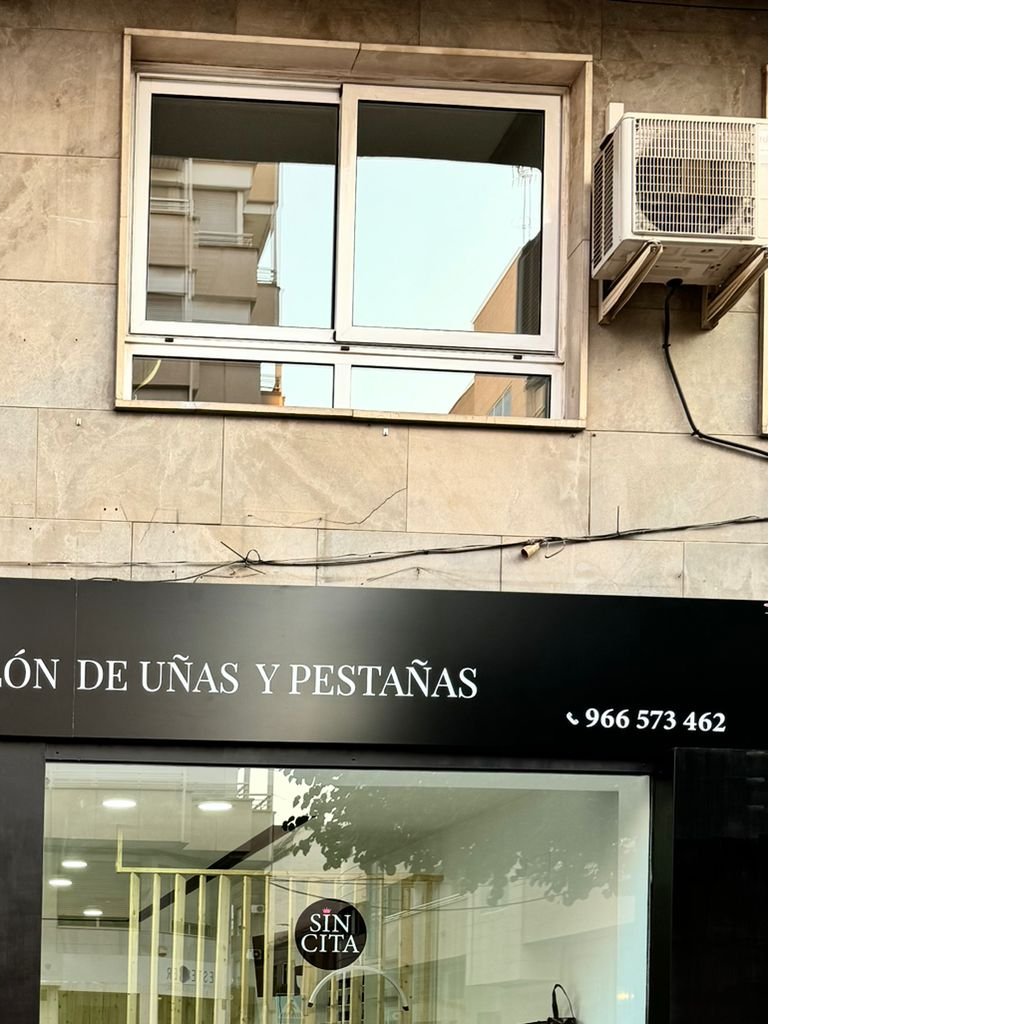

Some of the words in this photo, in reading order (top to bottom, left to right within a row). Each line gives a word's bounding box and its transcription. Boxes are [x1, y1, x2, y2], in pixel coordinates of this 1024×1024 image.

[76, 659, 128, 691] DE
[139, 655, 239, 694] UÑAS
[255, 663, 281, 695] Y
[287, 659, 478, 699] PESTAÑAS
[585, 708, 630, 728] 966
[636, 709, 676, 730] 573
[683, 711, 726, 732] 462
[310, 913, 352, 933] SIN
[301, 933, 360, 953] CITA
